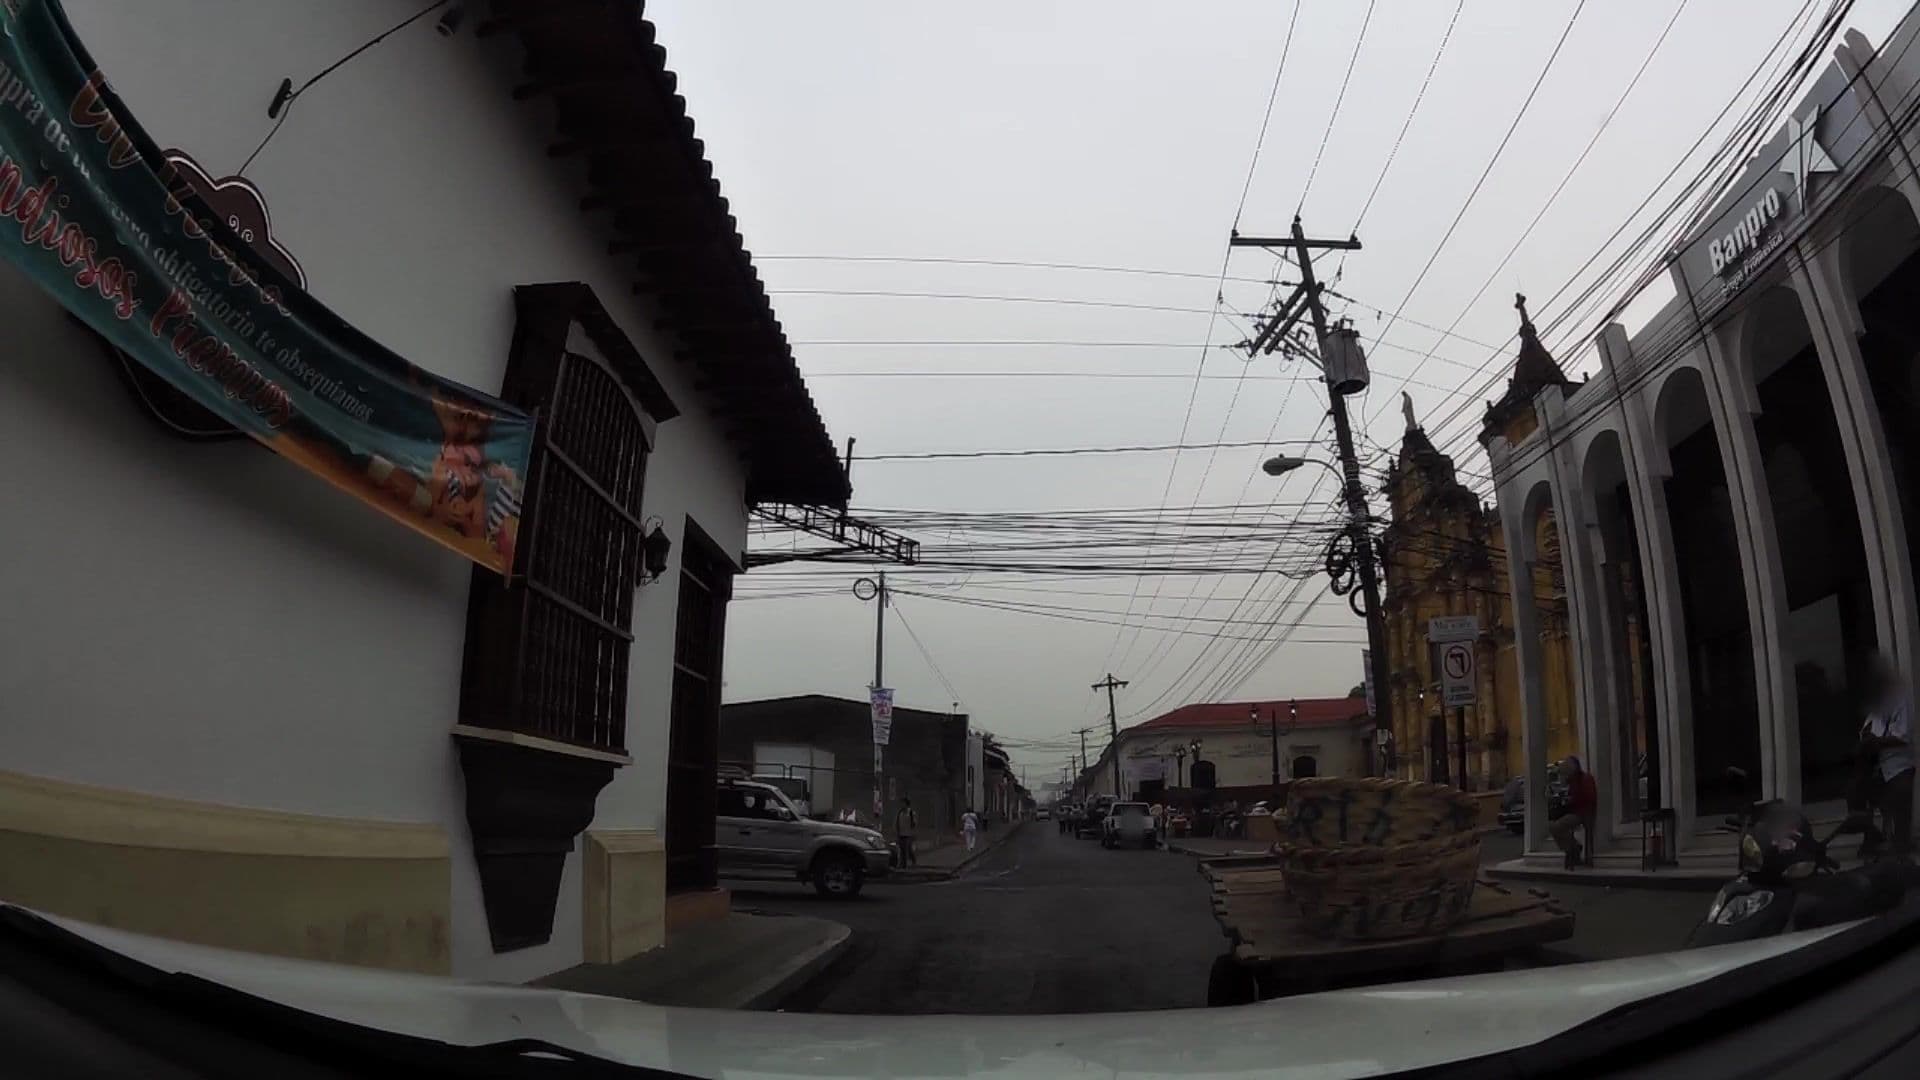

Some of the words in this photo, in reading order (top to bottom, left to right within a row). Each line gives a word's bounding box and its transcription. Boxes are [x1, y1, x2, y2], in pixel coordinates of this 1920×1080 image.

[1708, 187, 1780, 275] Banpro
[153, 246, 256, 340] obligatorio
[256, 328, 276, 353] te
